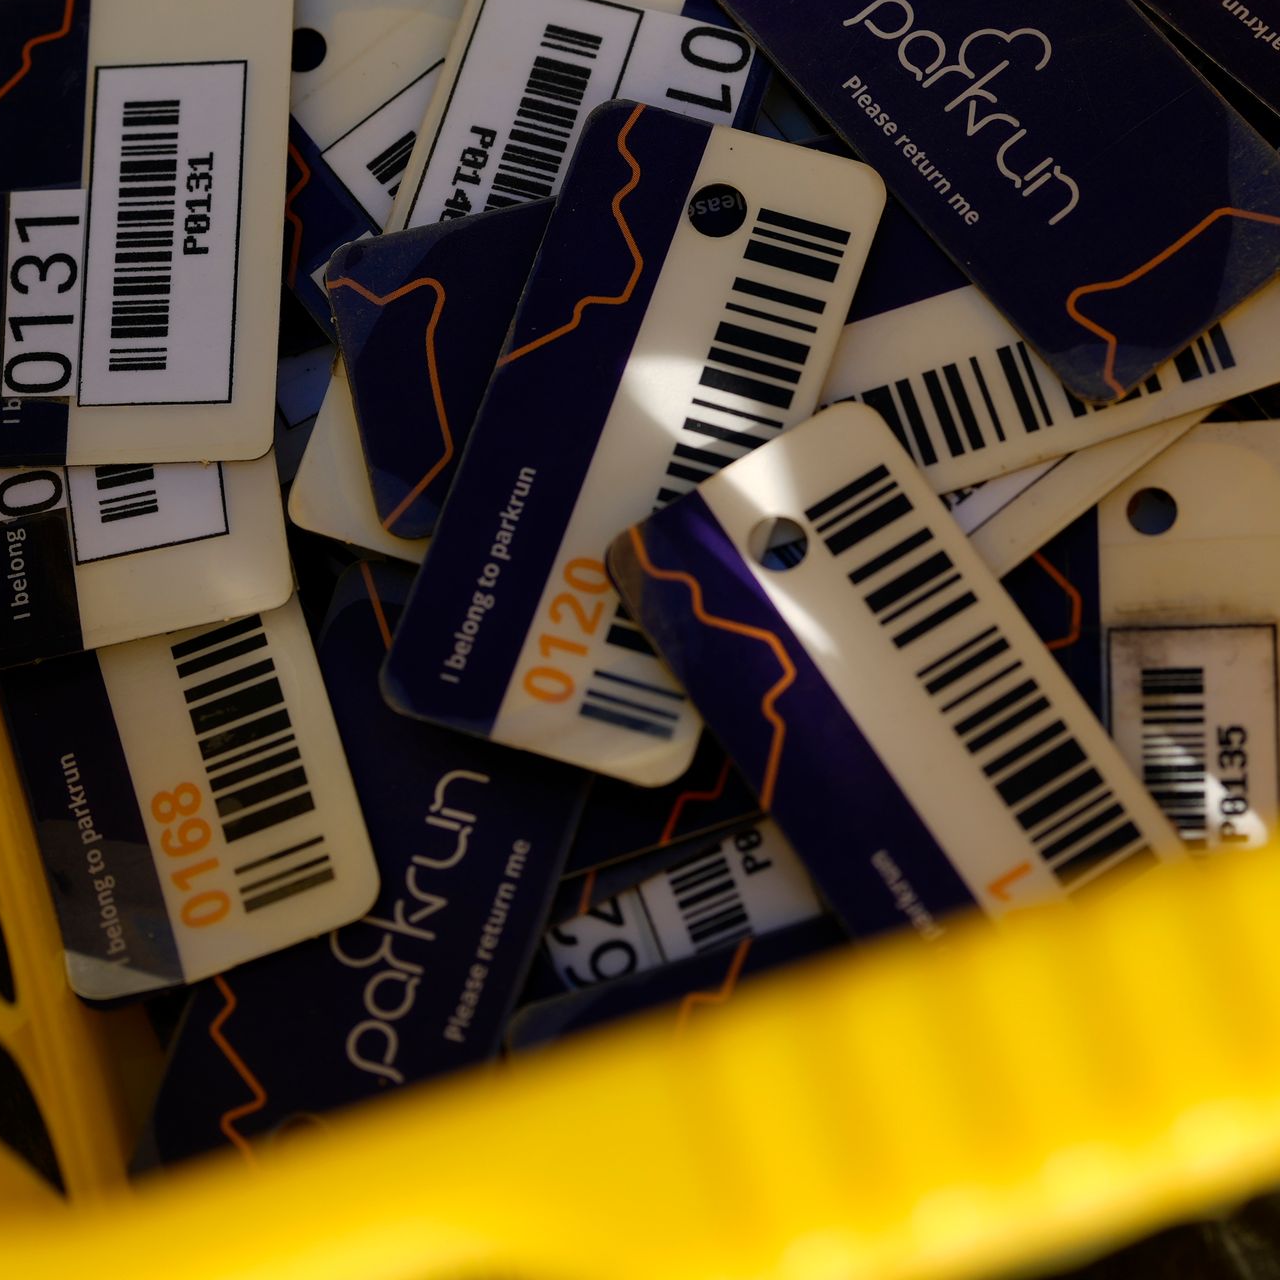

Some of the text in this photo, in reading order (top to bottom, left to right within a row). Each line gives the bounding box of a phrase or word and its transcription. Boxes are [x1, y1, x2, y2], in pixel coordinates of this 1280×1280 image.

[841, 75, 980, 226] Please return me
[183, 152, 215, 256] P0131
[4, 216, 80, 394] 0131
[489, 465, 538, 562] parkrun
[6, 527, 32, 609] belong
[477, 561, 502, 589] to
[443, 589, 497, 671] belong
[524, 558, 612, 704] 0120
[60, 751, 104, 845] parkrun
[86, 847, 106, 876] to
[151, 782, 231, 928] 0168
[93, 874, 127, 955] belong
[328, 768, 492, 1085] parkrun
[442, 837, 533, 1044] Please return me
